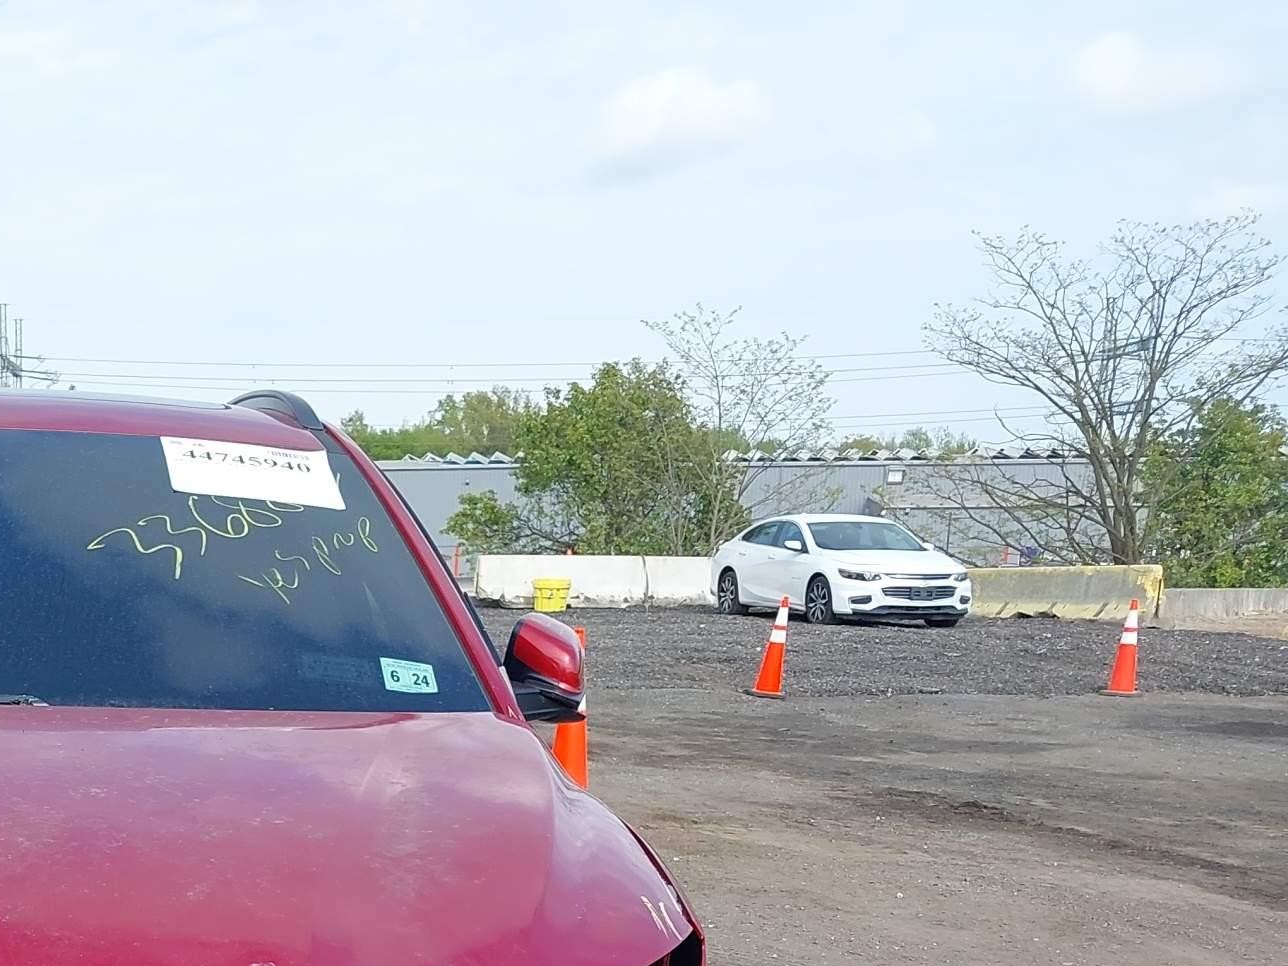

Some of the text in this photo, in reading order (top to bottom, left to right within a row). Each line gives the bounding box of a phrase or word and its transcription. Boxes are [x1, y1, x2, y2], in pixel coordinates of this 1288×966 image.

[182, 449, 311, 474] 44745940
[390, 669, 431, 688] 6 24
